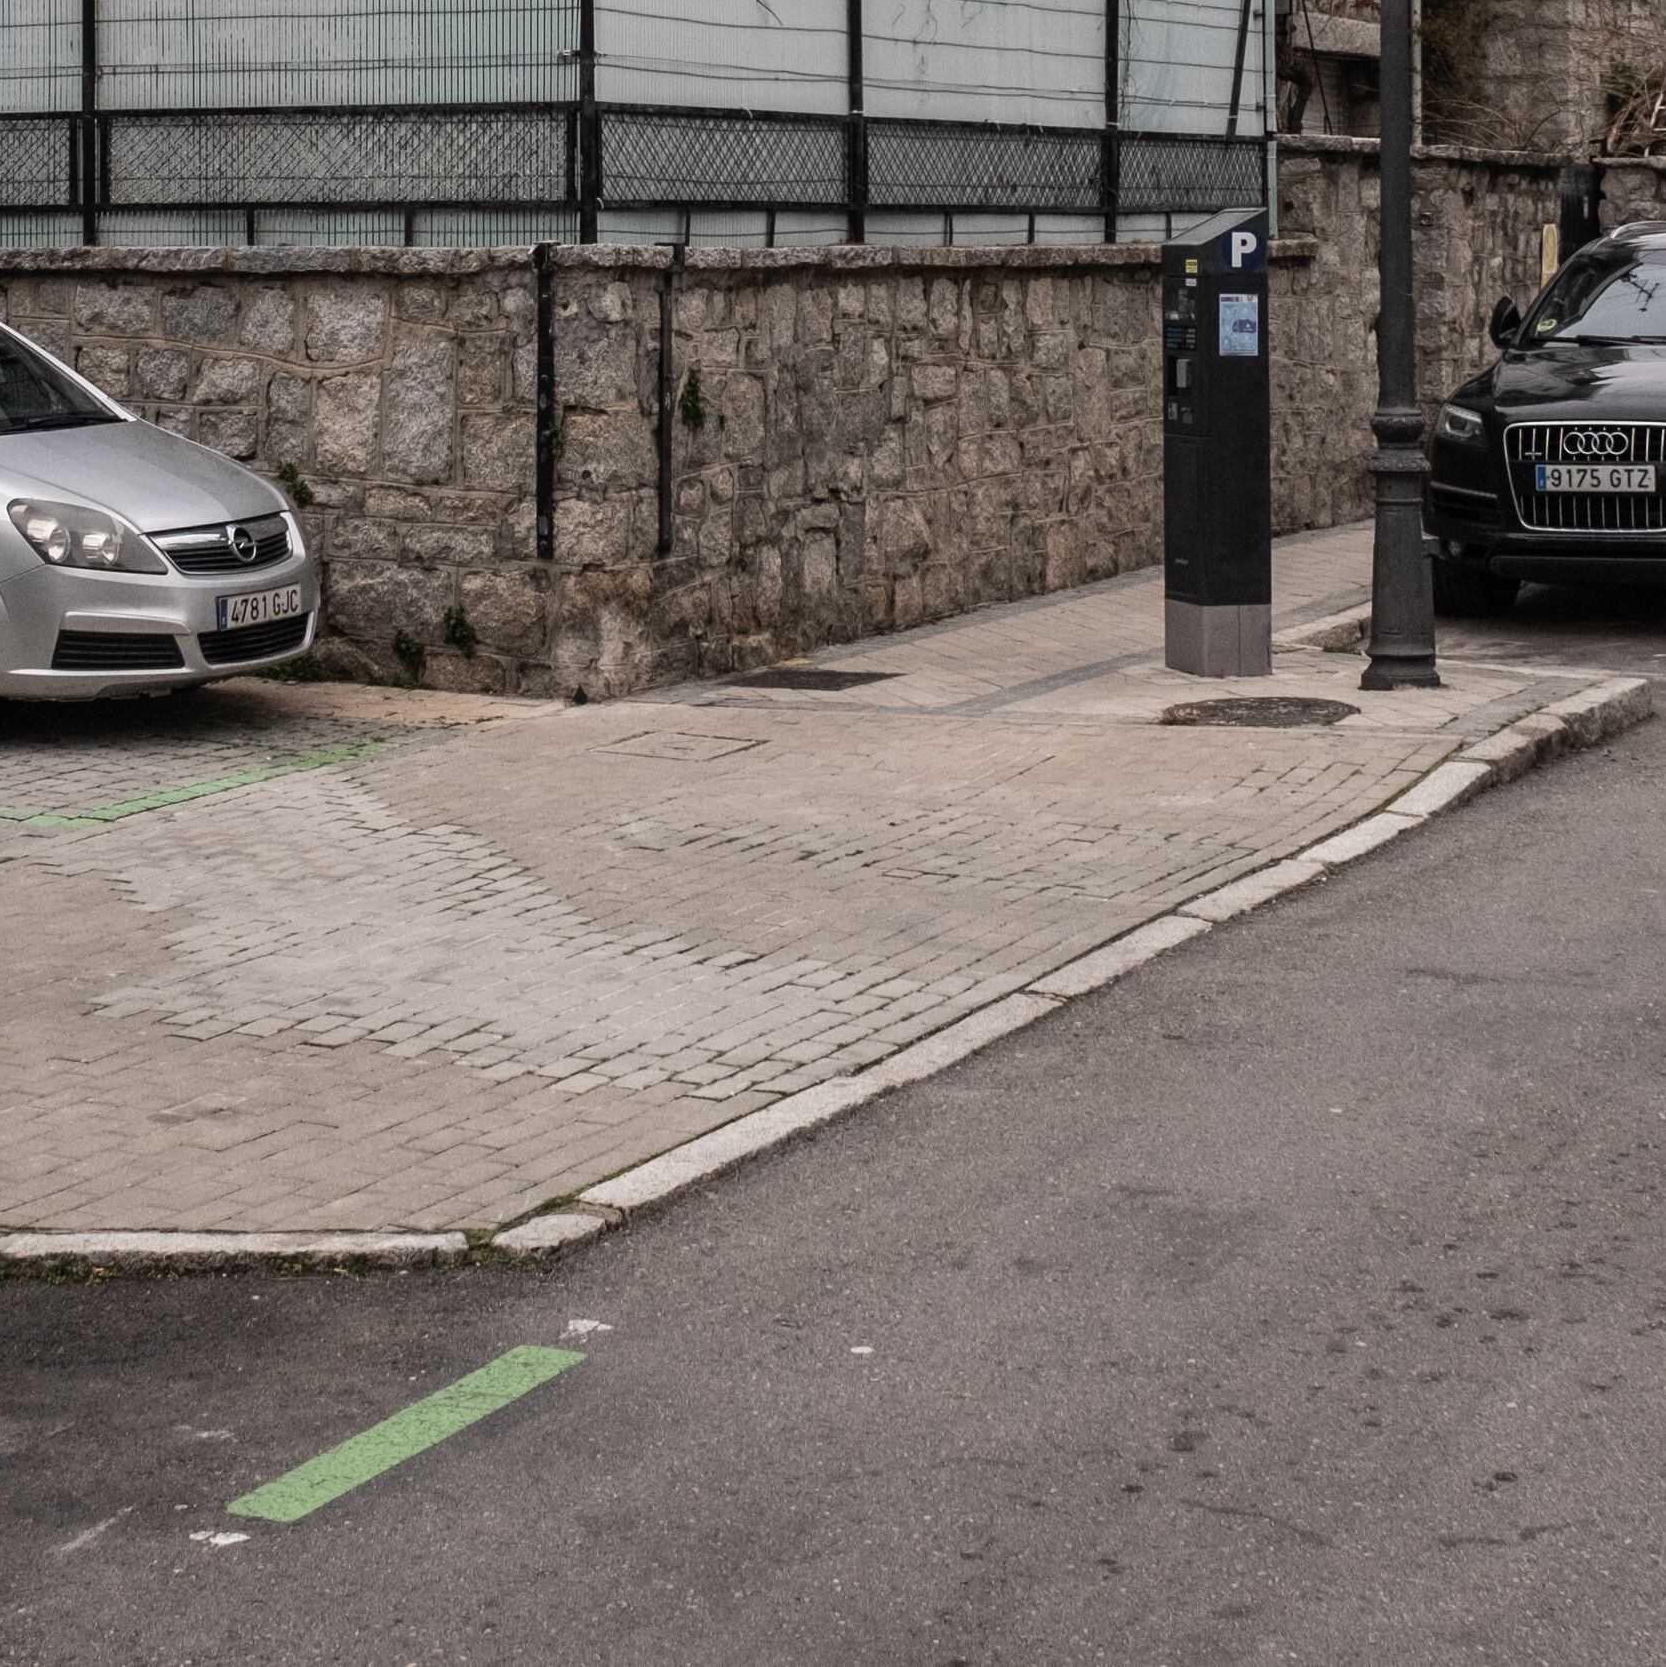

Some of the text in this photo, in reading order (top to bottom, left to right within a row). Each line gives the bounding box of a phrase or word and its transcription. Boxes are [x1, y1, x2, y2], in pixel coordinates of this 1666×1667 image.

[1231, 232, 1257, 267] P
[1550, 468, 1650, 489] 9175 GTZ
[231, 589, 299, 624] 4781 GJC
